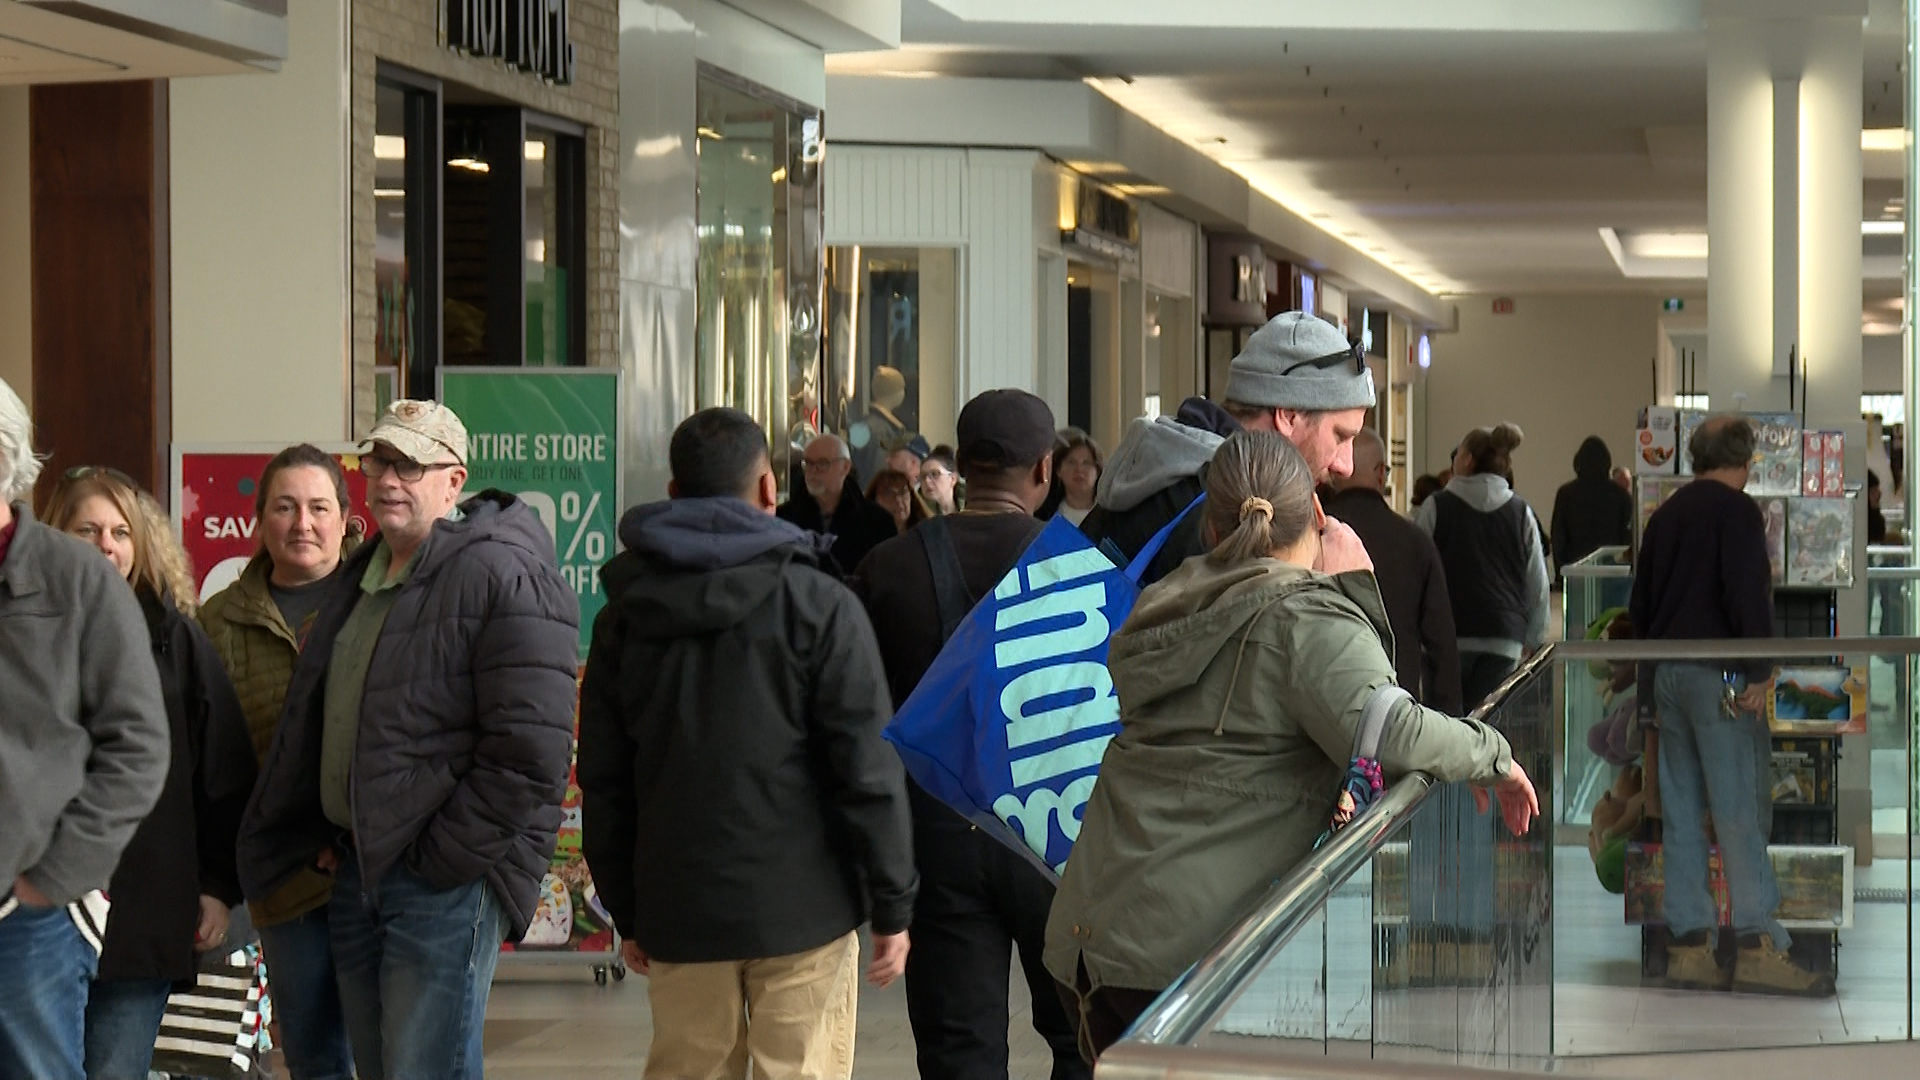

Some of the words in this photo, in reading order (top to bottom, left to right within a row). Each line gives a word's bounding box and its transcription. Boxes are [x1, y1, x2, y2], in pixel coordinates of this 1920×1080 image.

[467, 433, 528, 462] NTIRE
[534, 433, 606, 462] STORE
[471, 465, 495, 480] BUY
[532, 465, 556, 480] GET
[560, 465, 585, 480] ONE
[203, 516, 257, 539] SAV
